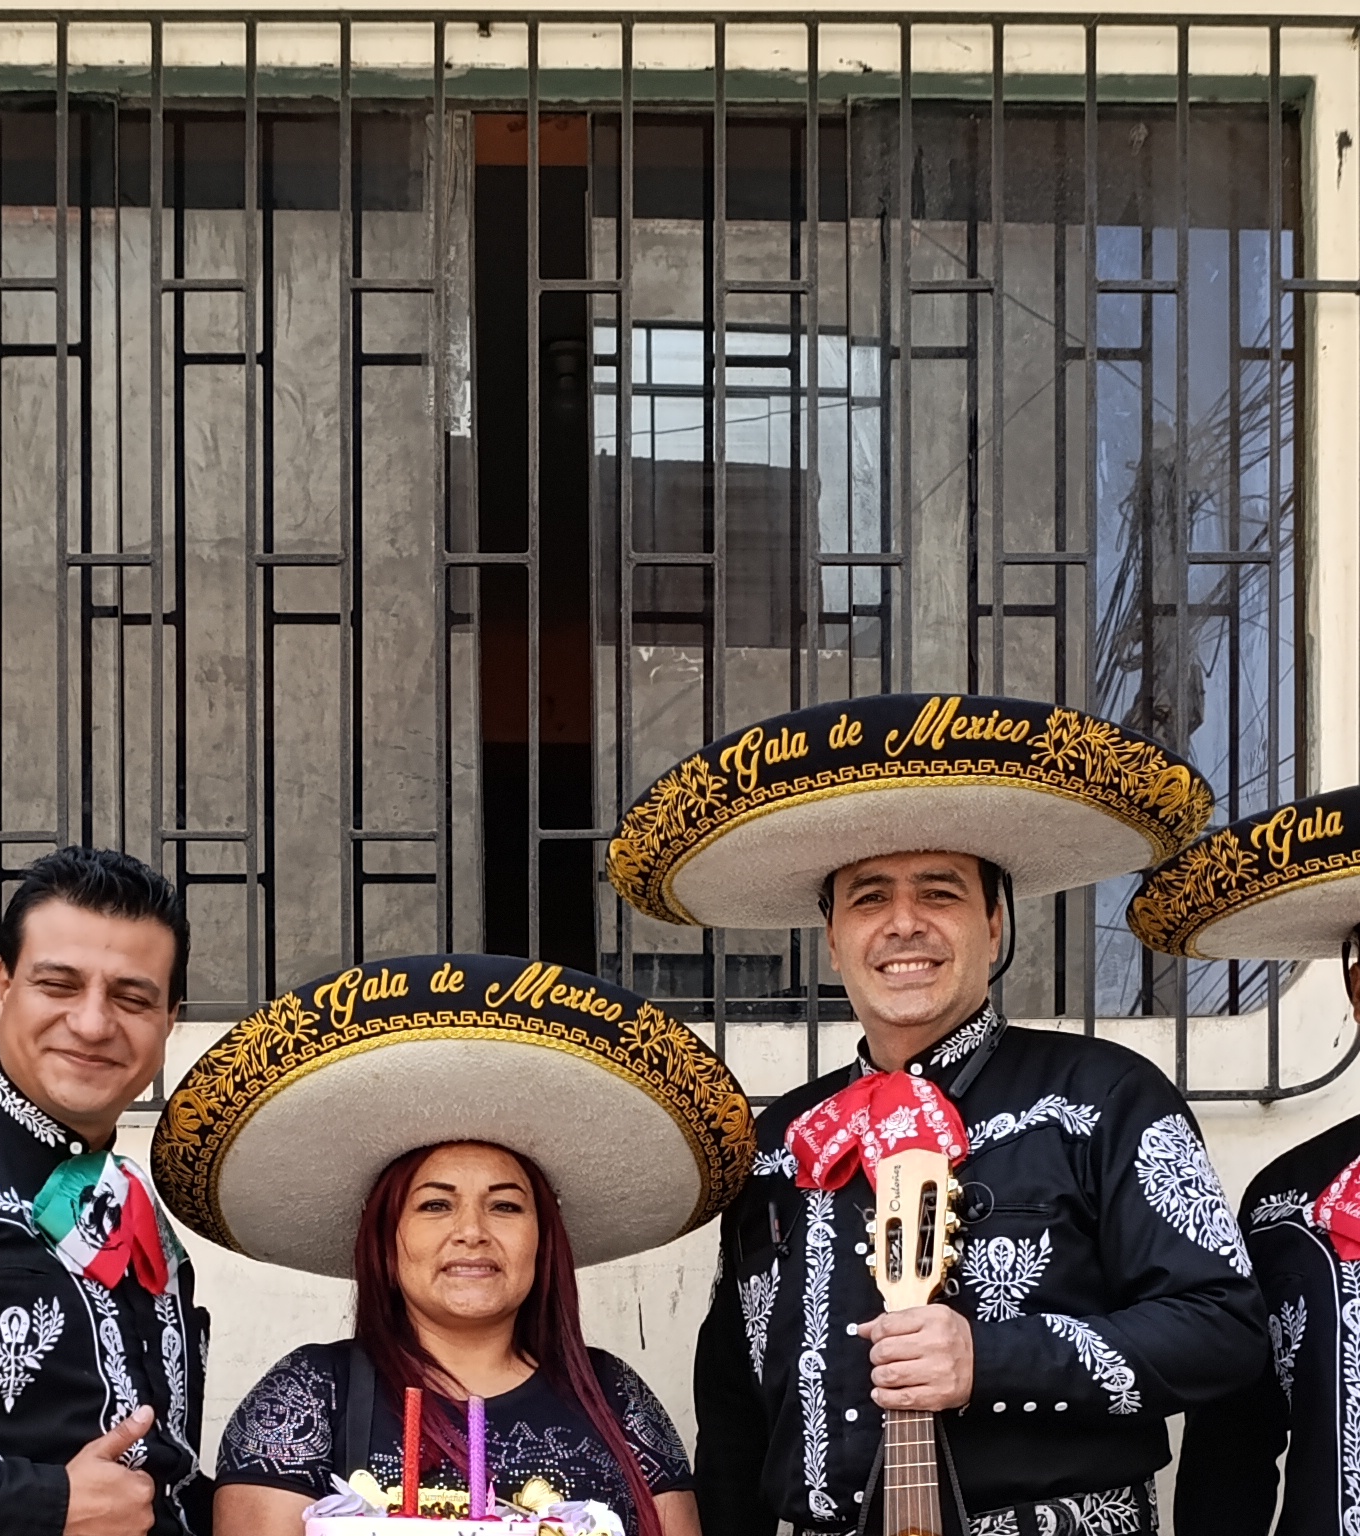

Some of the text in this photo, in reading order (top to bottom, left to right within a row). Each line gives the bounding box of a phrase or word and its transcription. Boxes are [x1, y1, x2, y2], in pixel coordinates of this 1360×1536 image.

[720, 696, 1030, 793] Gala de Mexico
[1250, 806, 1344, 869] Gala
[313, 961, 622, 1029] Gala de Mexico
[820, 1099, 841, 1122] Gala
